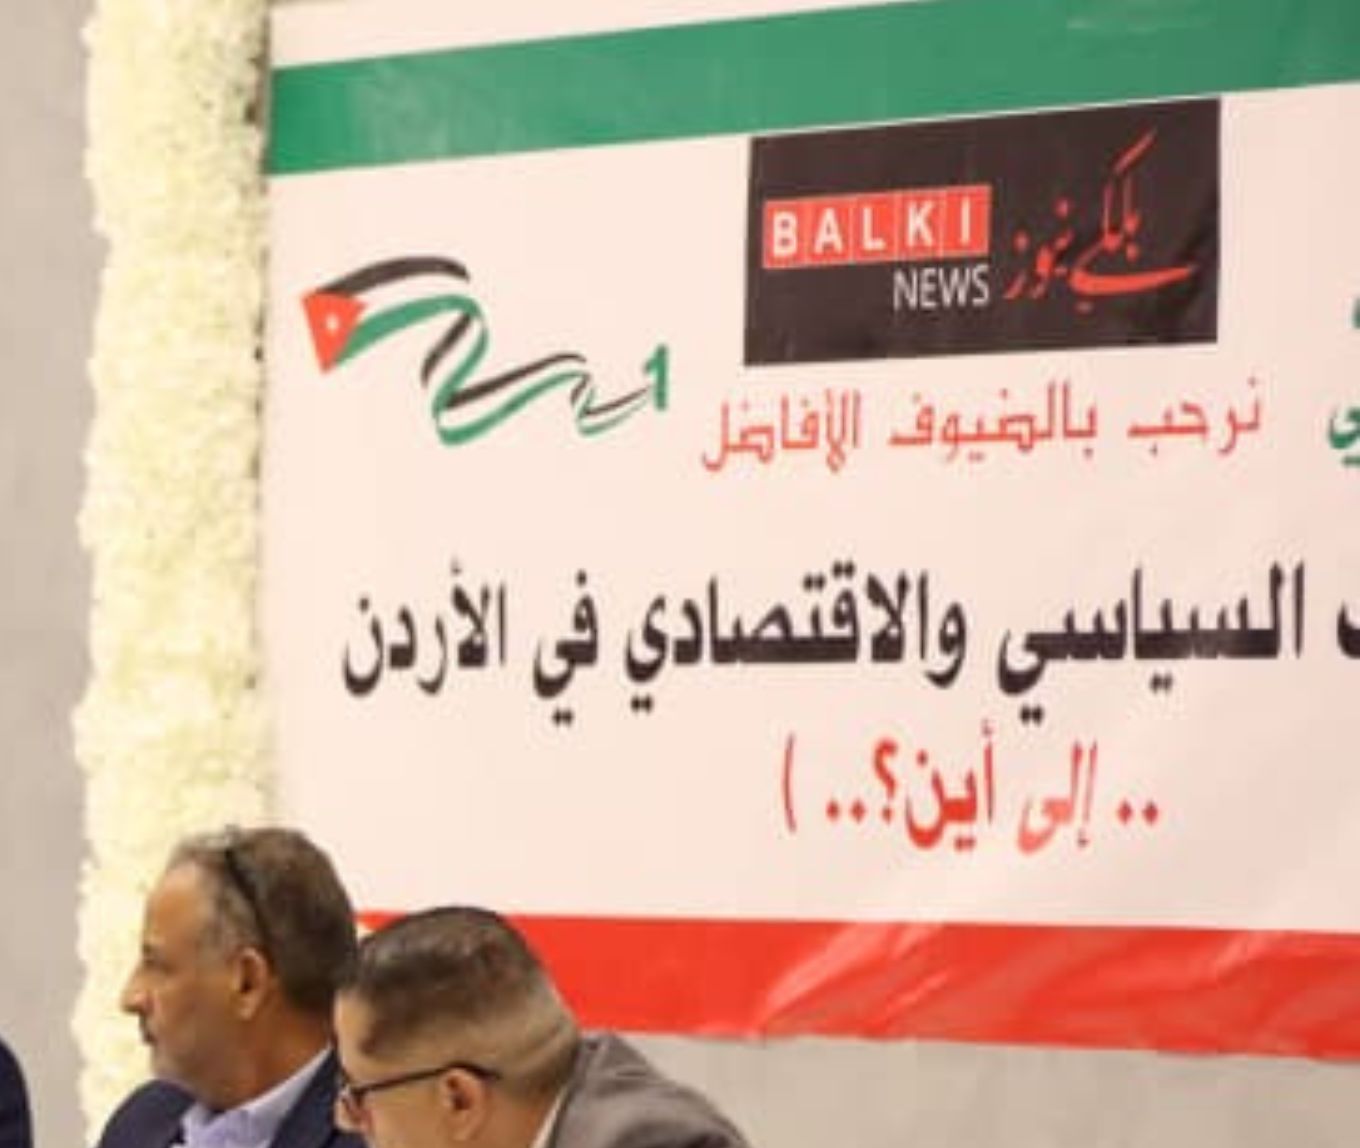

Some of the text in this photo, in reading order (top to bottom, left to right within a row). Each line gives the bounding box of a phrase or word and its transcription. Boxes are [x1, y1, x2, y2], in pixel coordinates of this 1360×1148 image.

[771, 200, 972, 258] BALKI
[893, 264, 990, 311] NEWS
[887, 380, 1098, 463] بالضيوف
[1128, 376, 1262, 456] نرحب
[343, 558, 1305, 724] السياسي والاقتصادي في الأردن
